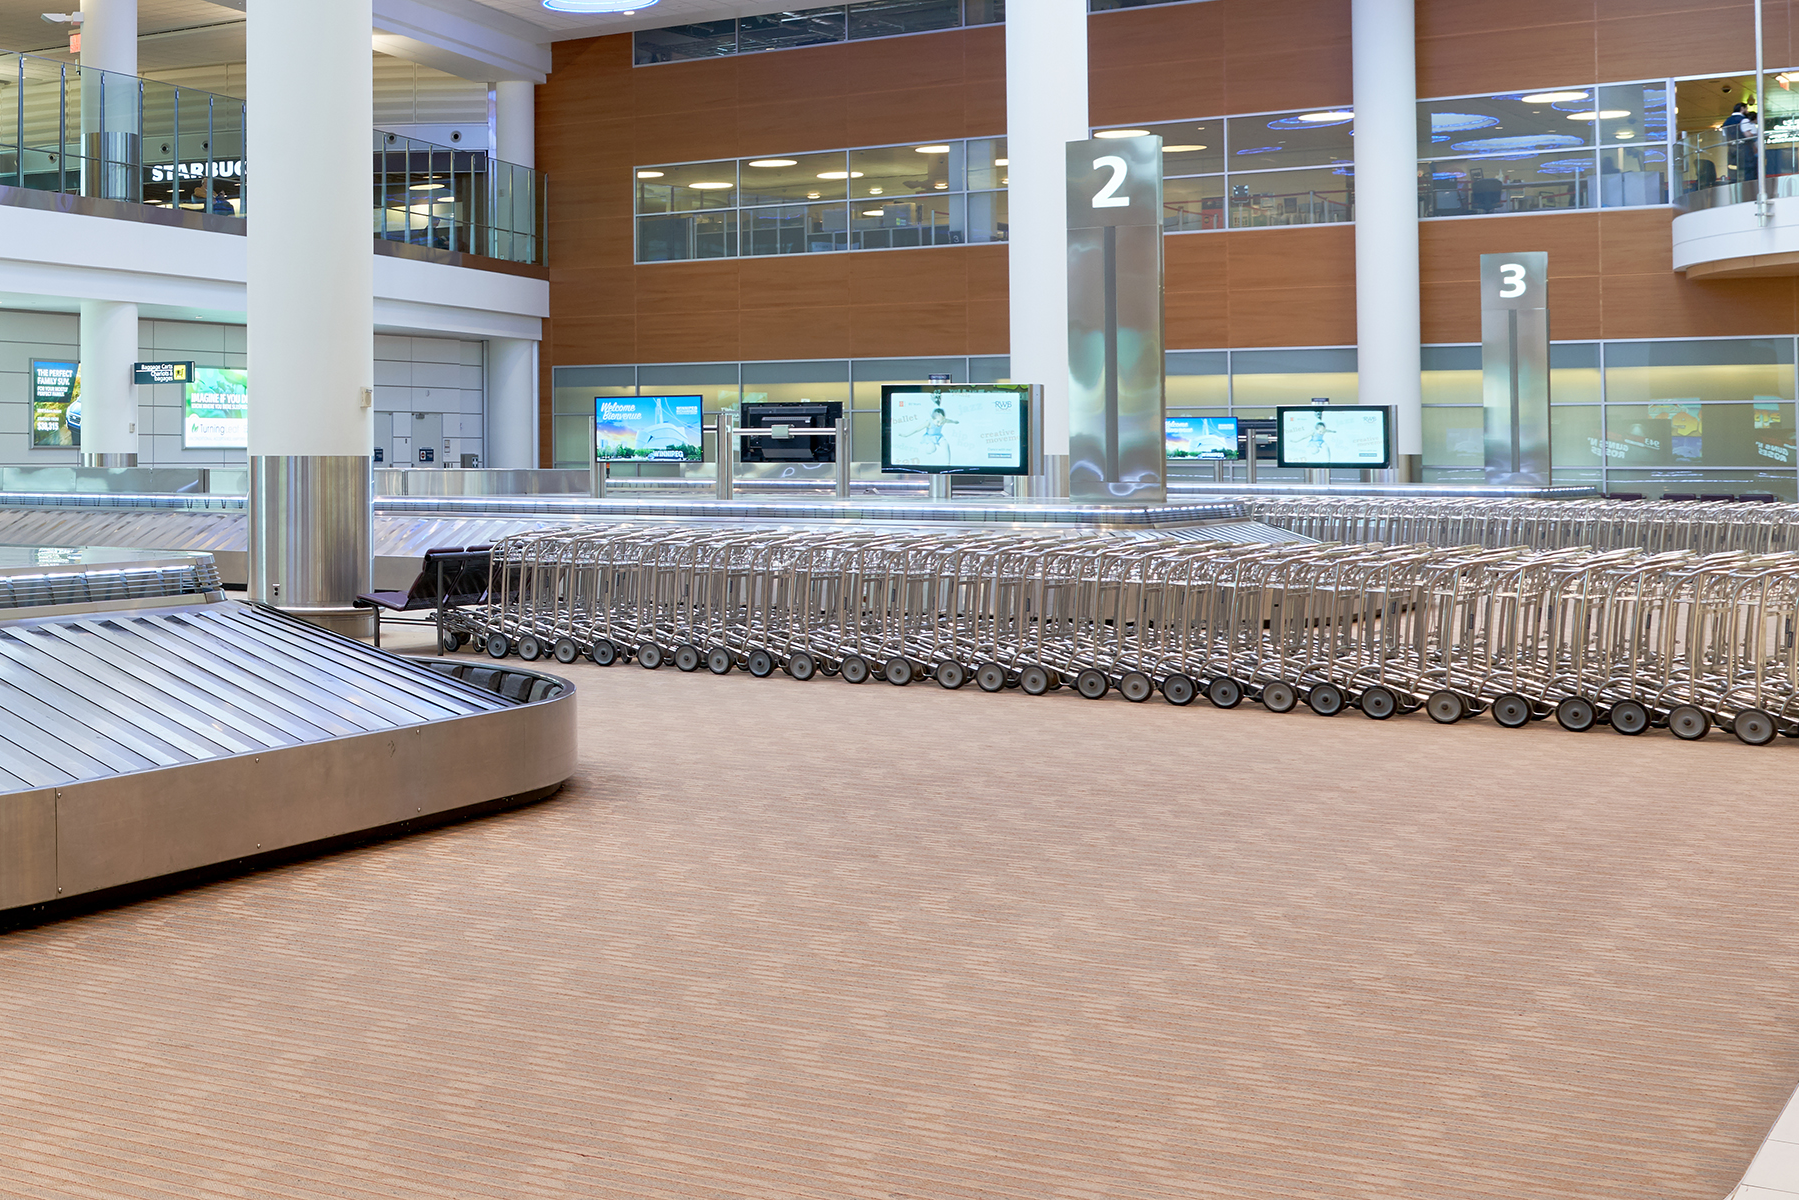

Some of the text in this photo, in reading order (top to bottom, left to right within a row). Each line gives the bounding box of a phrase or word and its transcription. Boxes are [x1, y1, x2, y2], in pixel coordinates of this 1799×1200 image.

[1092, 155, 1130, 208] 2
[1500, 263, 1527, 298] 3
[37, 368, 73, 377] THE PERFECT
[191, 393, 219, 403] IMAGINE
[220, 393, 226, 403] IF
[227, 394, 240, 403] YOU
[601, 402, 636, 412] Welcome
[603, 411, 642, 420] Bienvenue
[893, 414, 918, 424] ballet
[980, 429, 1014, 439] creative
[653, 450, 684, 458] WINNIPEG
